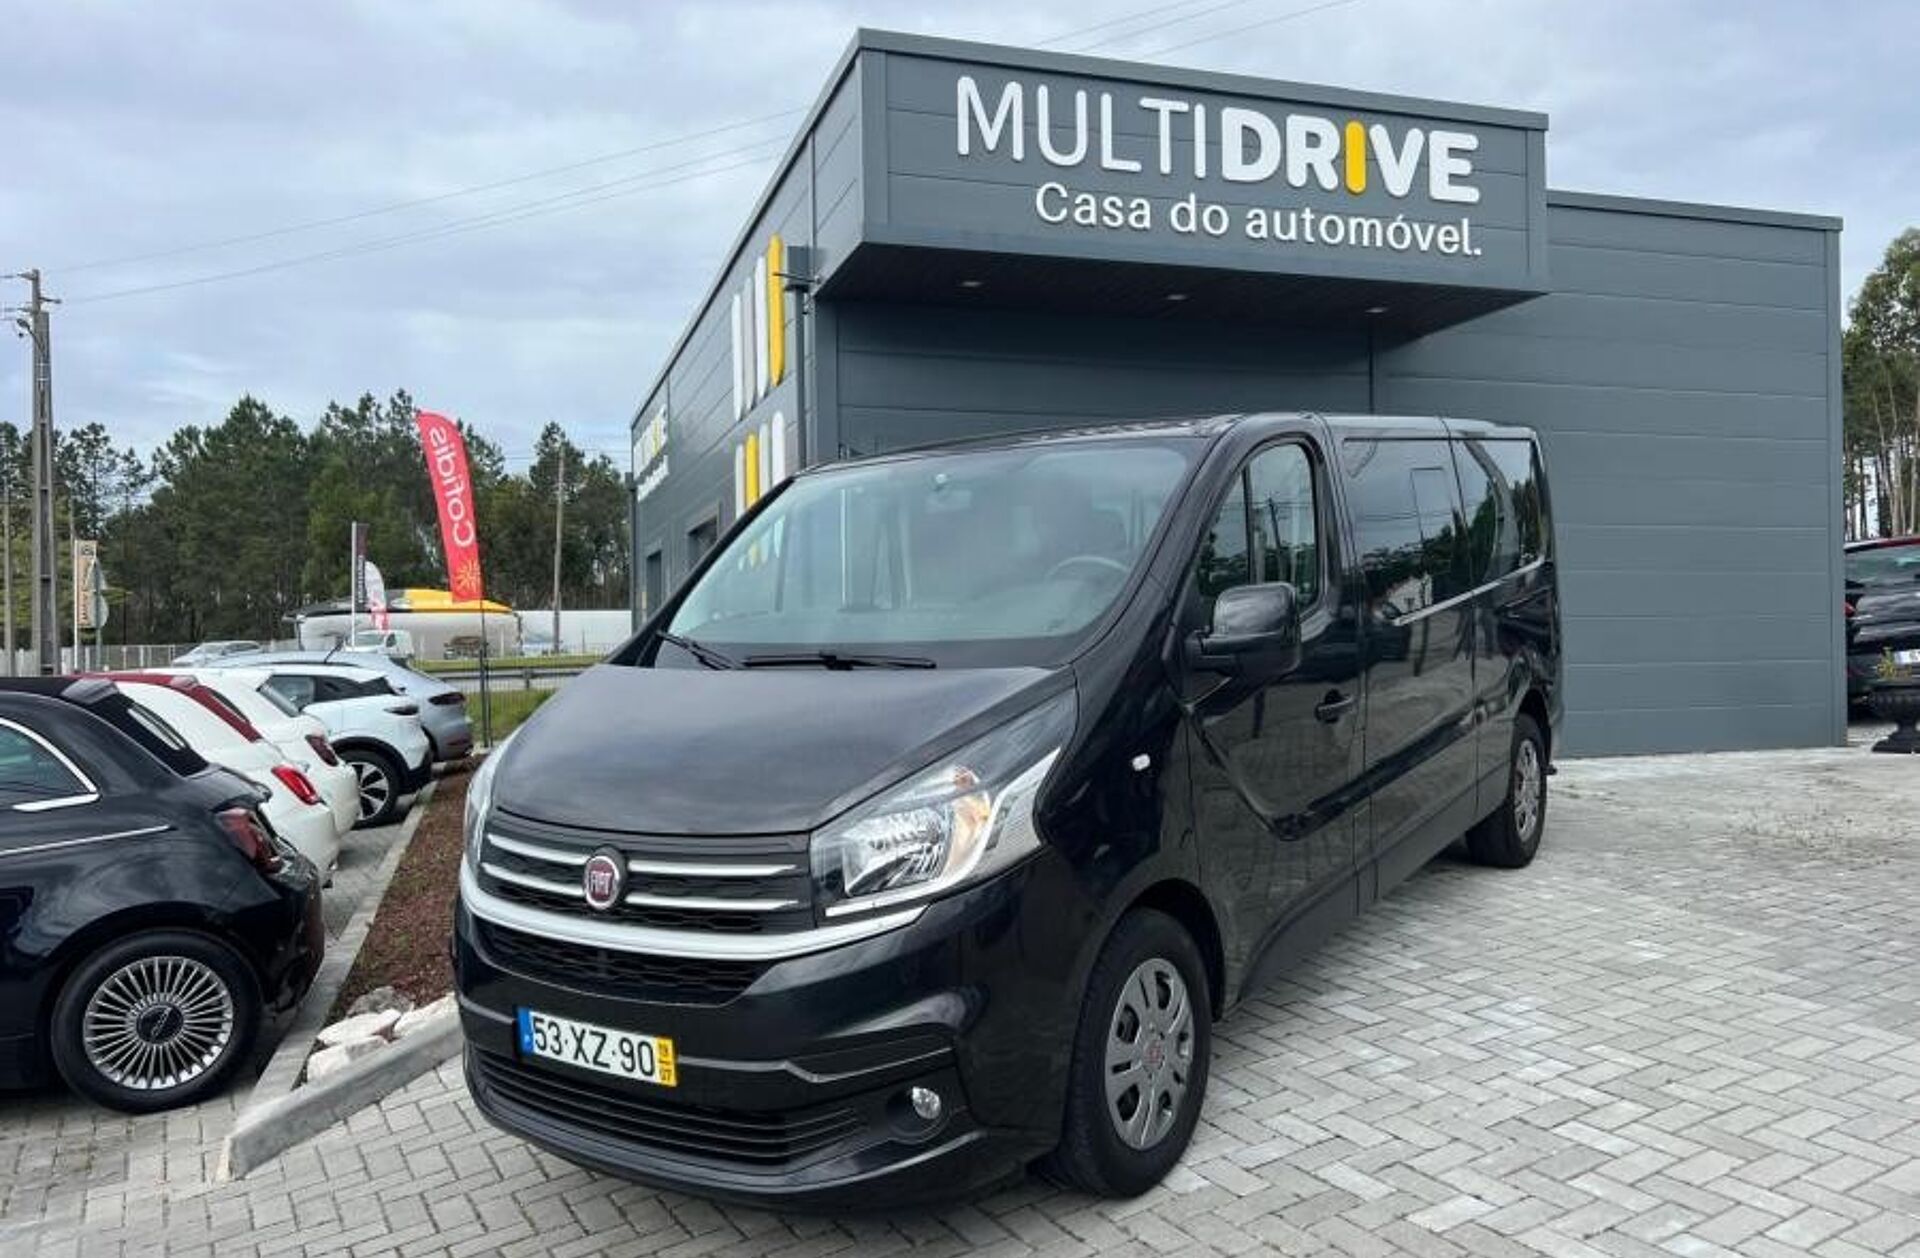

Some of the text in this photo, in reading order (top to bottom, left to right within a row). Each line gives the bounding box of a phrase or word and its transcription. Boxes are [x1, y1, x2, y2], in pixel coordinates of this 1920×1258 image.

[956, 76, 1480, 202] MULTIDRIVE
[1035, 182, 1482, 256] Casa do automóvel.
